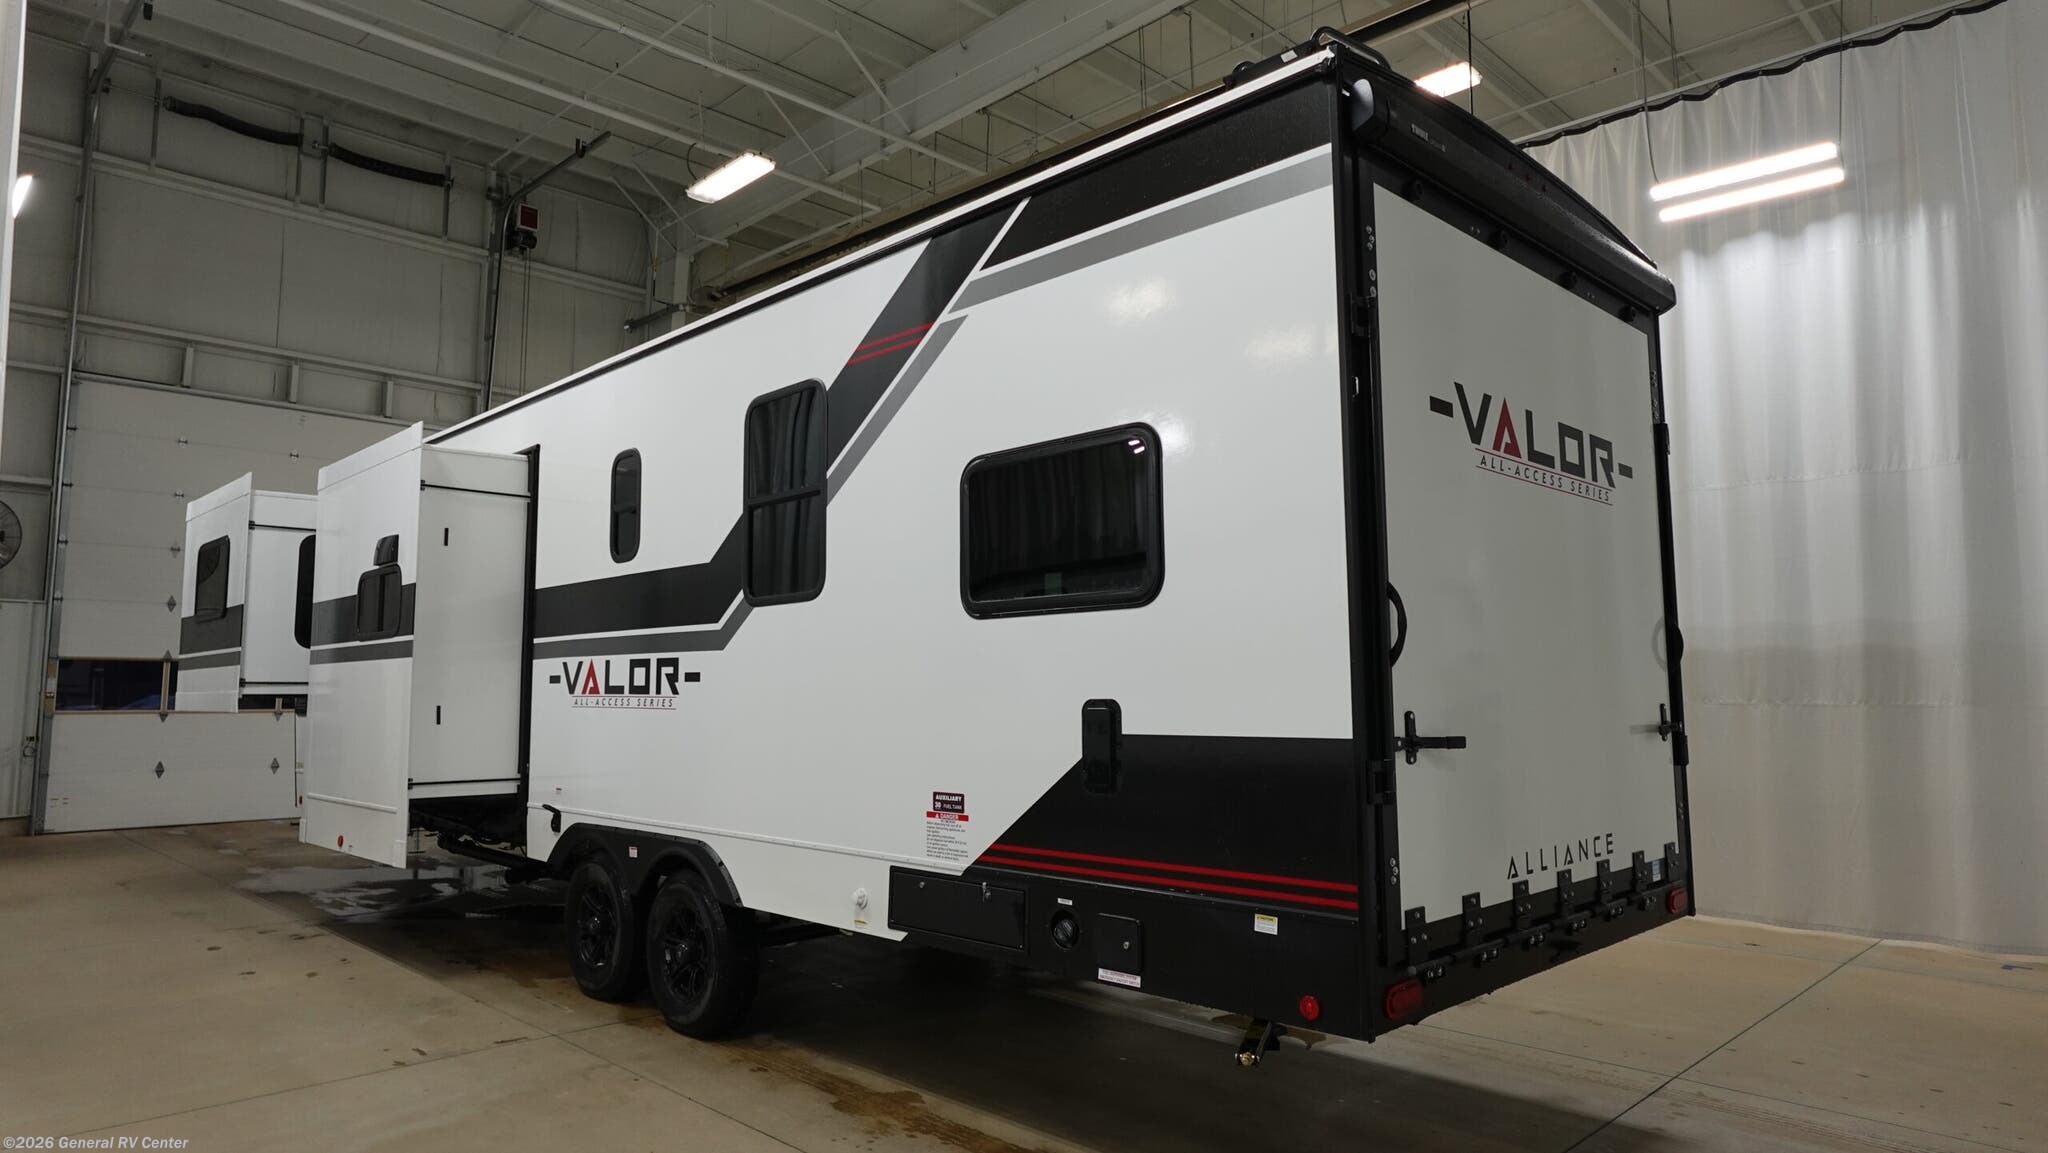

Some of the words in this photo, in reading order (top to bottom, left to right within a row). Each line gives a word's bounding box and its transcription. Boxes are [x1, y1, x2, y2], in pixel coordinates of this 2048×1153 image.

[1480, 455, 1564, 488] ALL-ACCESS
[1570, 480, 1610, 502] SERIES
[574, 698, 631, 707] ALL-ACCESS
[637, 698, 673, 708] SERIES
[935, 793, 962, 802] AUXILIARY
[1507, 832, 1614, 880] ALLIANCE
